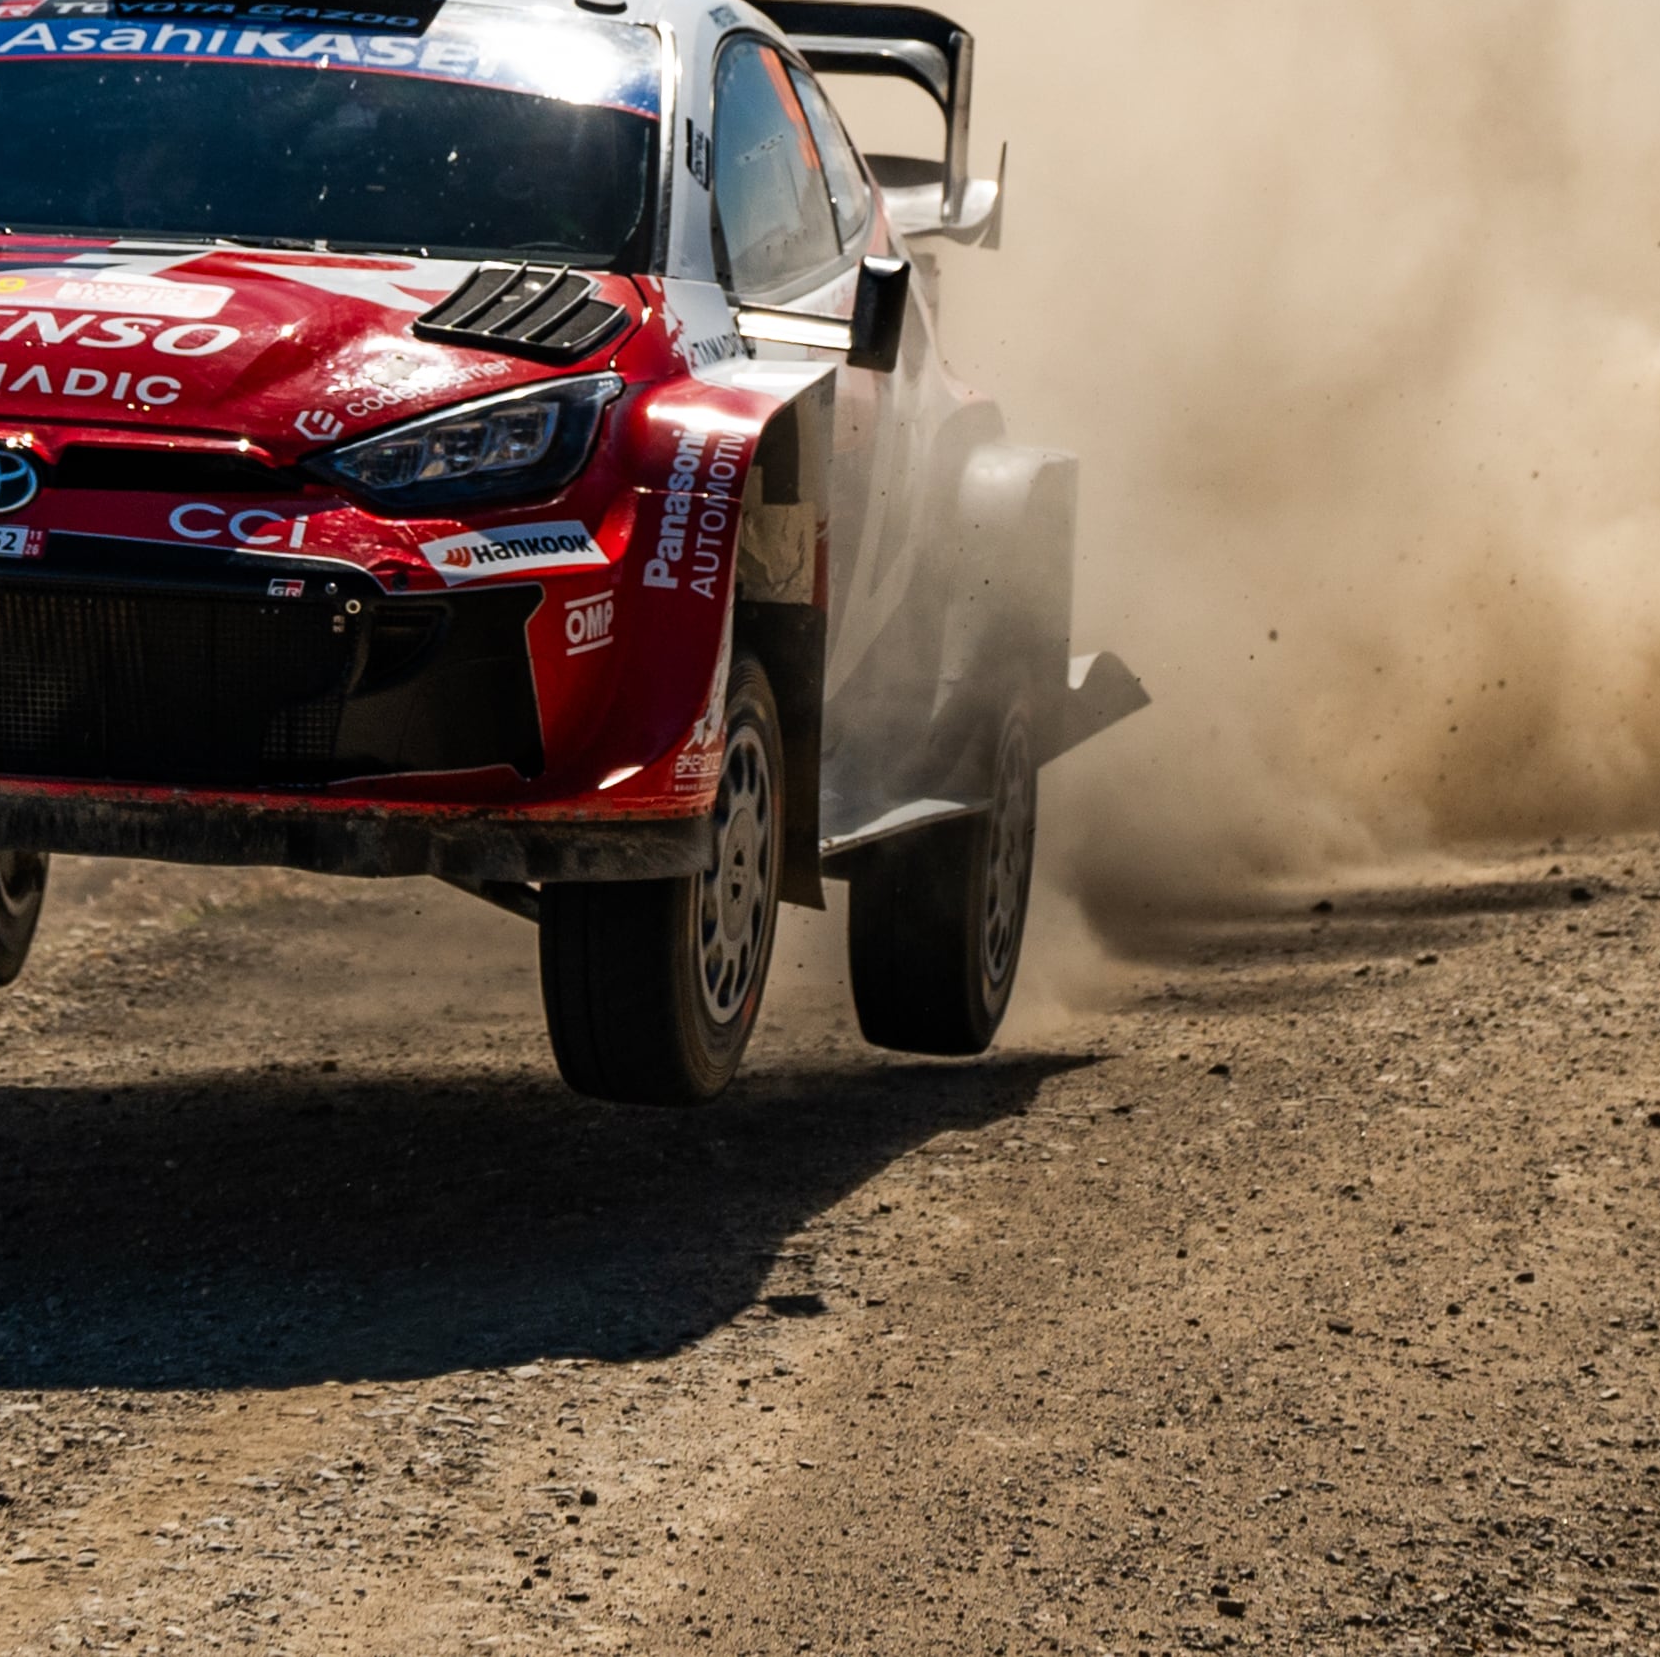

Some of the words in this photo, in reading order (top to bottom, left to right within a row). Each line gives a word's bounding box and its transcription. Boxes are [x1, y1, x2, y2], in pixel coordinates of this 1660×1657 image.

[54, 0, 236, 15] TOYOTA
[247, 3, 420, 28] GAZOO
[642, 429, 709, 589] Panasoni
[690, 430, 747, 600] AUTOMOTIV
[269, 583, 303, 597] GR
[565, 599, 614, 645] OMP
